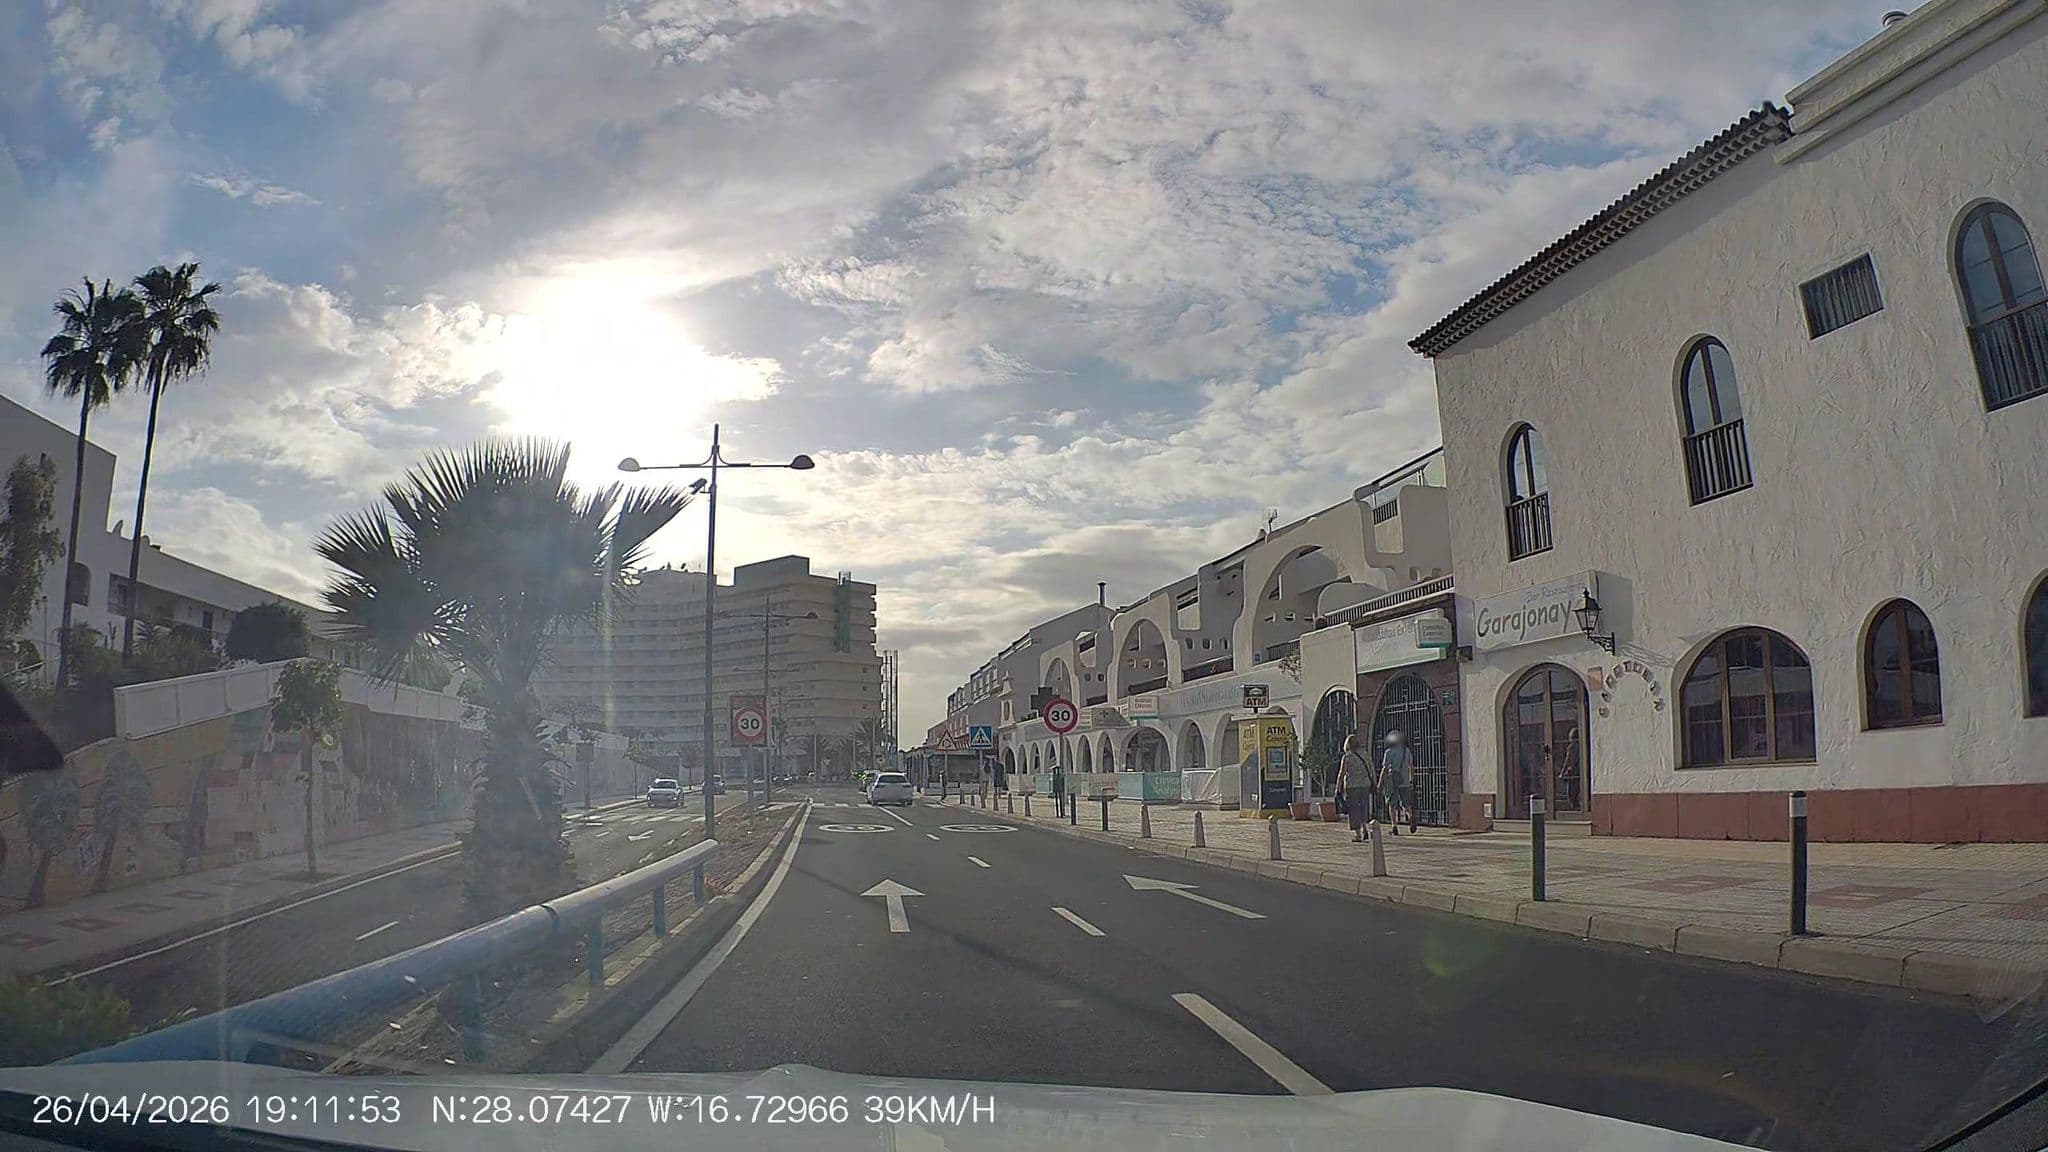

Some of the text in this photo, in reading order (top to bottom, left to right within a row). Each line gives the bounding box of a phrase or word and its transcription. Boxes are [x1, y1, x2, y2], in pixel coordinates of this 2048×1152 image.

[1477, 600, 1572, 641] Garajonay
[1246, 698, 1266, 706] ATM
[1051, 710, 1071, 721] 30
[741, 718, 760, 730] 30
[1266, 726, 1286, 735] ATM
